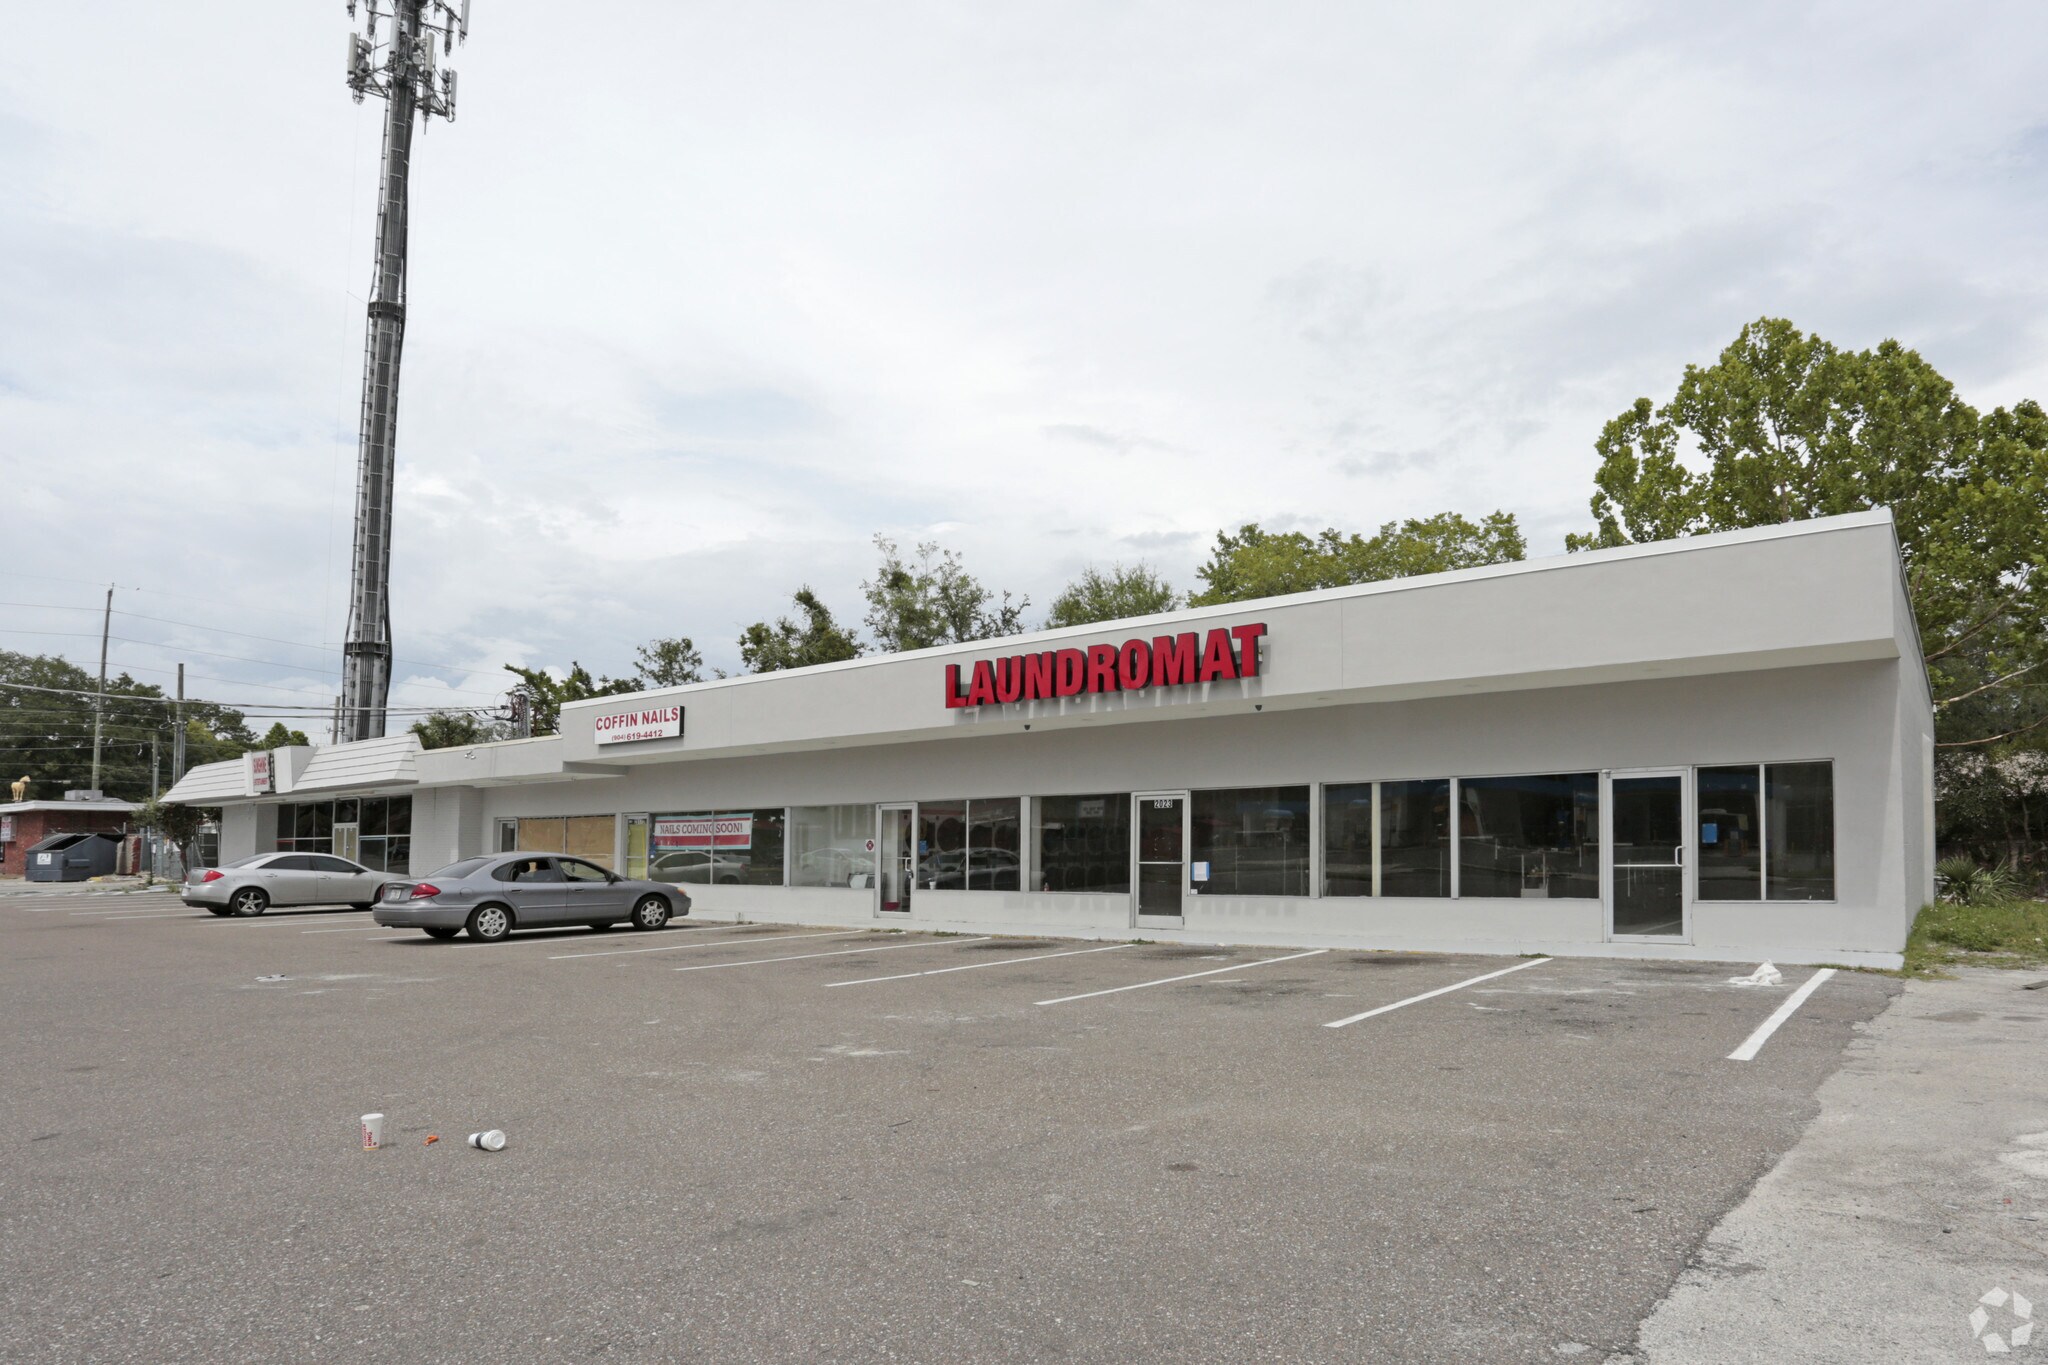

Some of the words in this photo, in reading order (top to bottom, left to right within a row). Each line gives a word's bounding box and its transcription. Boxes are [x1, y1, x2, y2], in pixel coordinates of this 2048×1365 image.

[945, 622, 1267, 708] LAUNDROMAT
[595, 713, 638, 731] COFFIN
[642, 707, 679, 725] NAILS
[626, 729, 663, 741] 619-4412
[1154, 799, 1173, 808] 2023
[660, 824, 681, 835] NAILS
[682, 823, 713, 834] COMING
[715, 822, 743, 833] SOON!
